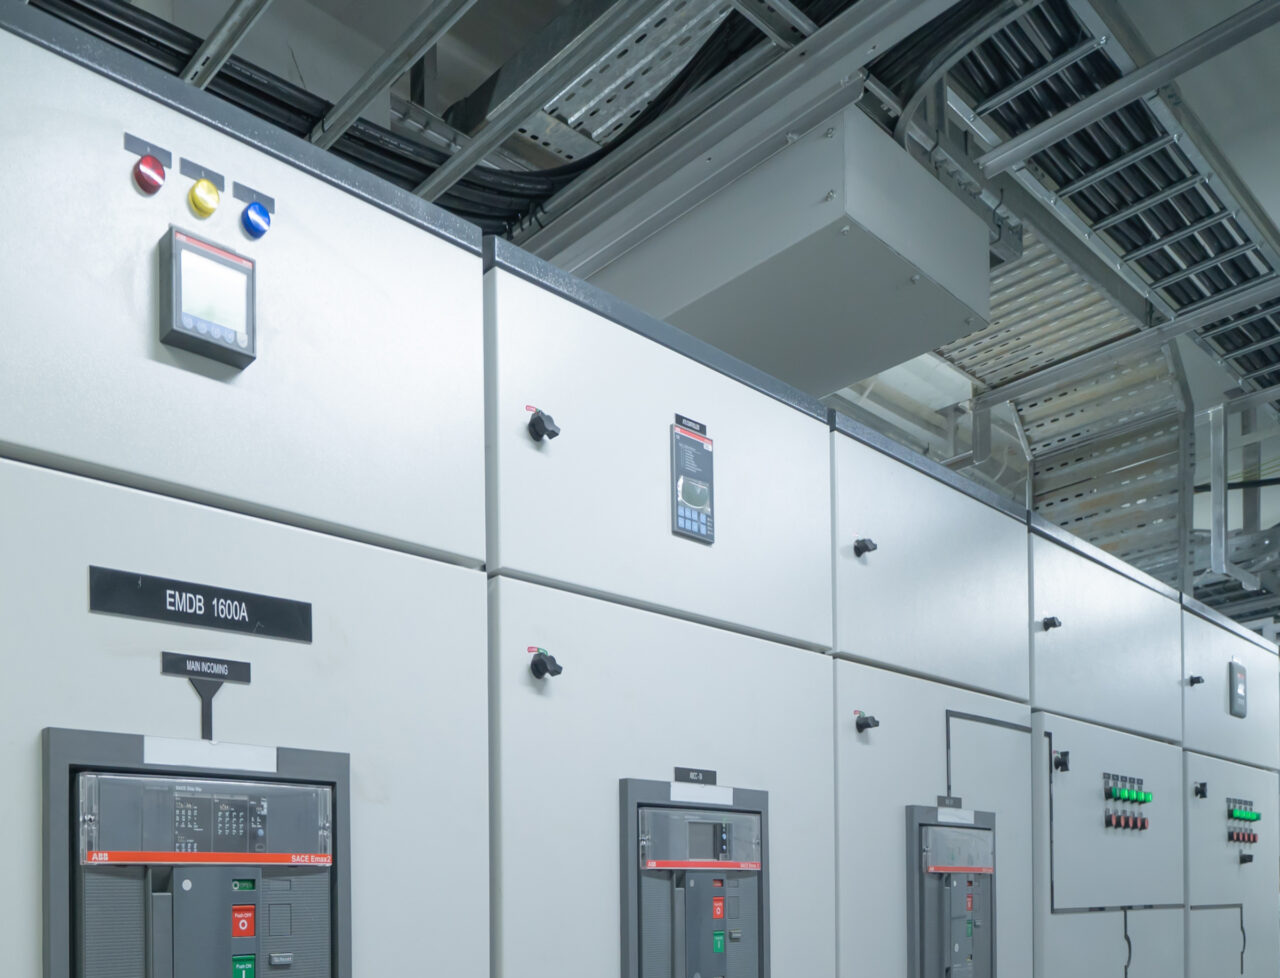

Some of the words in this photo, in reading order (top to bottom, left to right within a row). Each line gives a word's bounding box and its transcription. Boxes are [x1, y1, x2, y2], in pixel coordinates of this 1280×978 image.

[166, 589, 205, 614] EMDB
[212, 597, 249, 622] 1600A
[186, 660, 201, 672] MAIN
[201, 661, 228, 676] INCOMING
[92, 853, 108, 861] ABB
[291, 855, 309, 863] SACE
